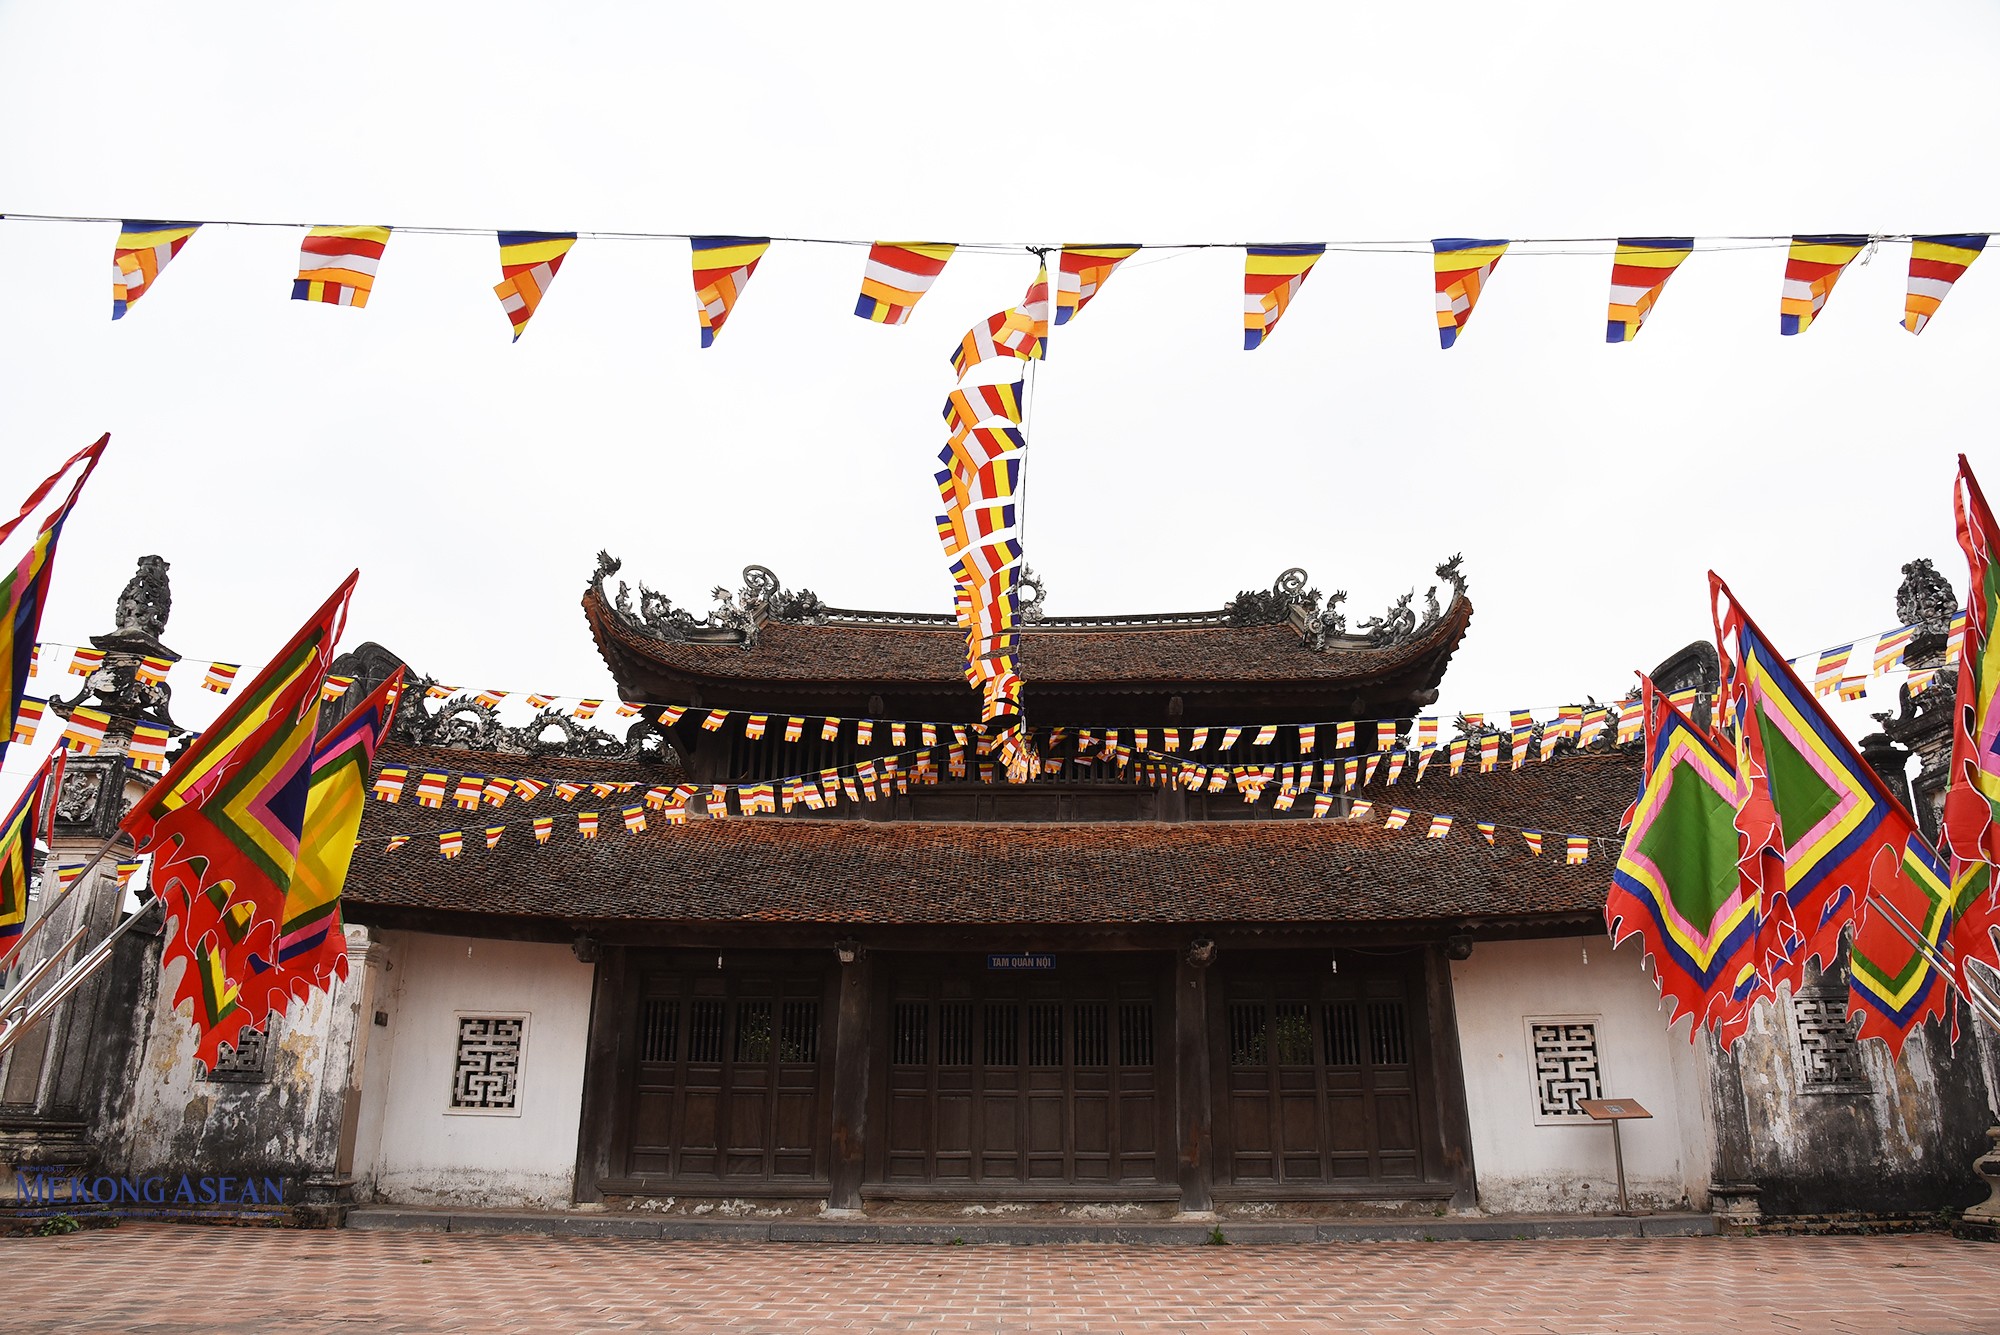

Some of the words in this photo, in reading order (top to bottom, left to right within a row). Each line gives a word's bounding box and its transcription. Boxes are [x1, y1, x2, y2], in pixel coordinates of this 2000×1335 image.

[992, 957, 1009, 966] TAM
[1011, 957, 1034, 967] QUAN
[1036, 956, 1051, 968] NỘI
